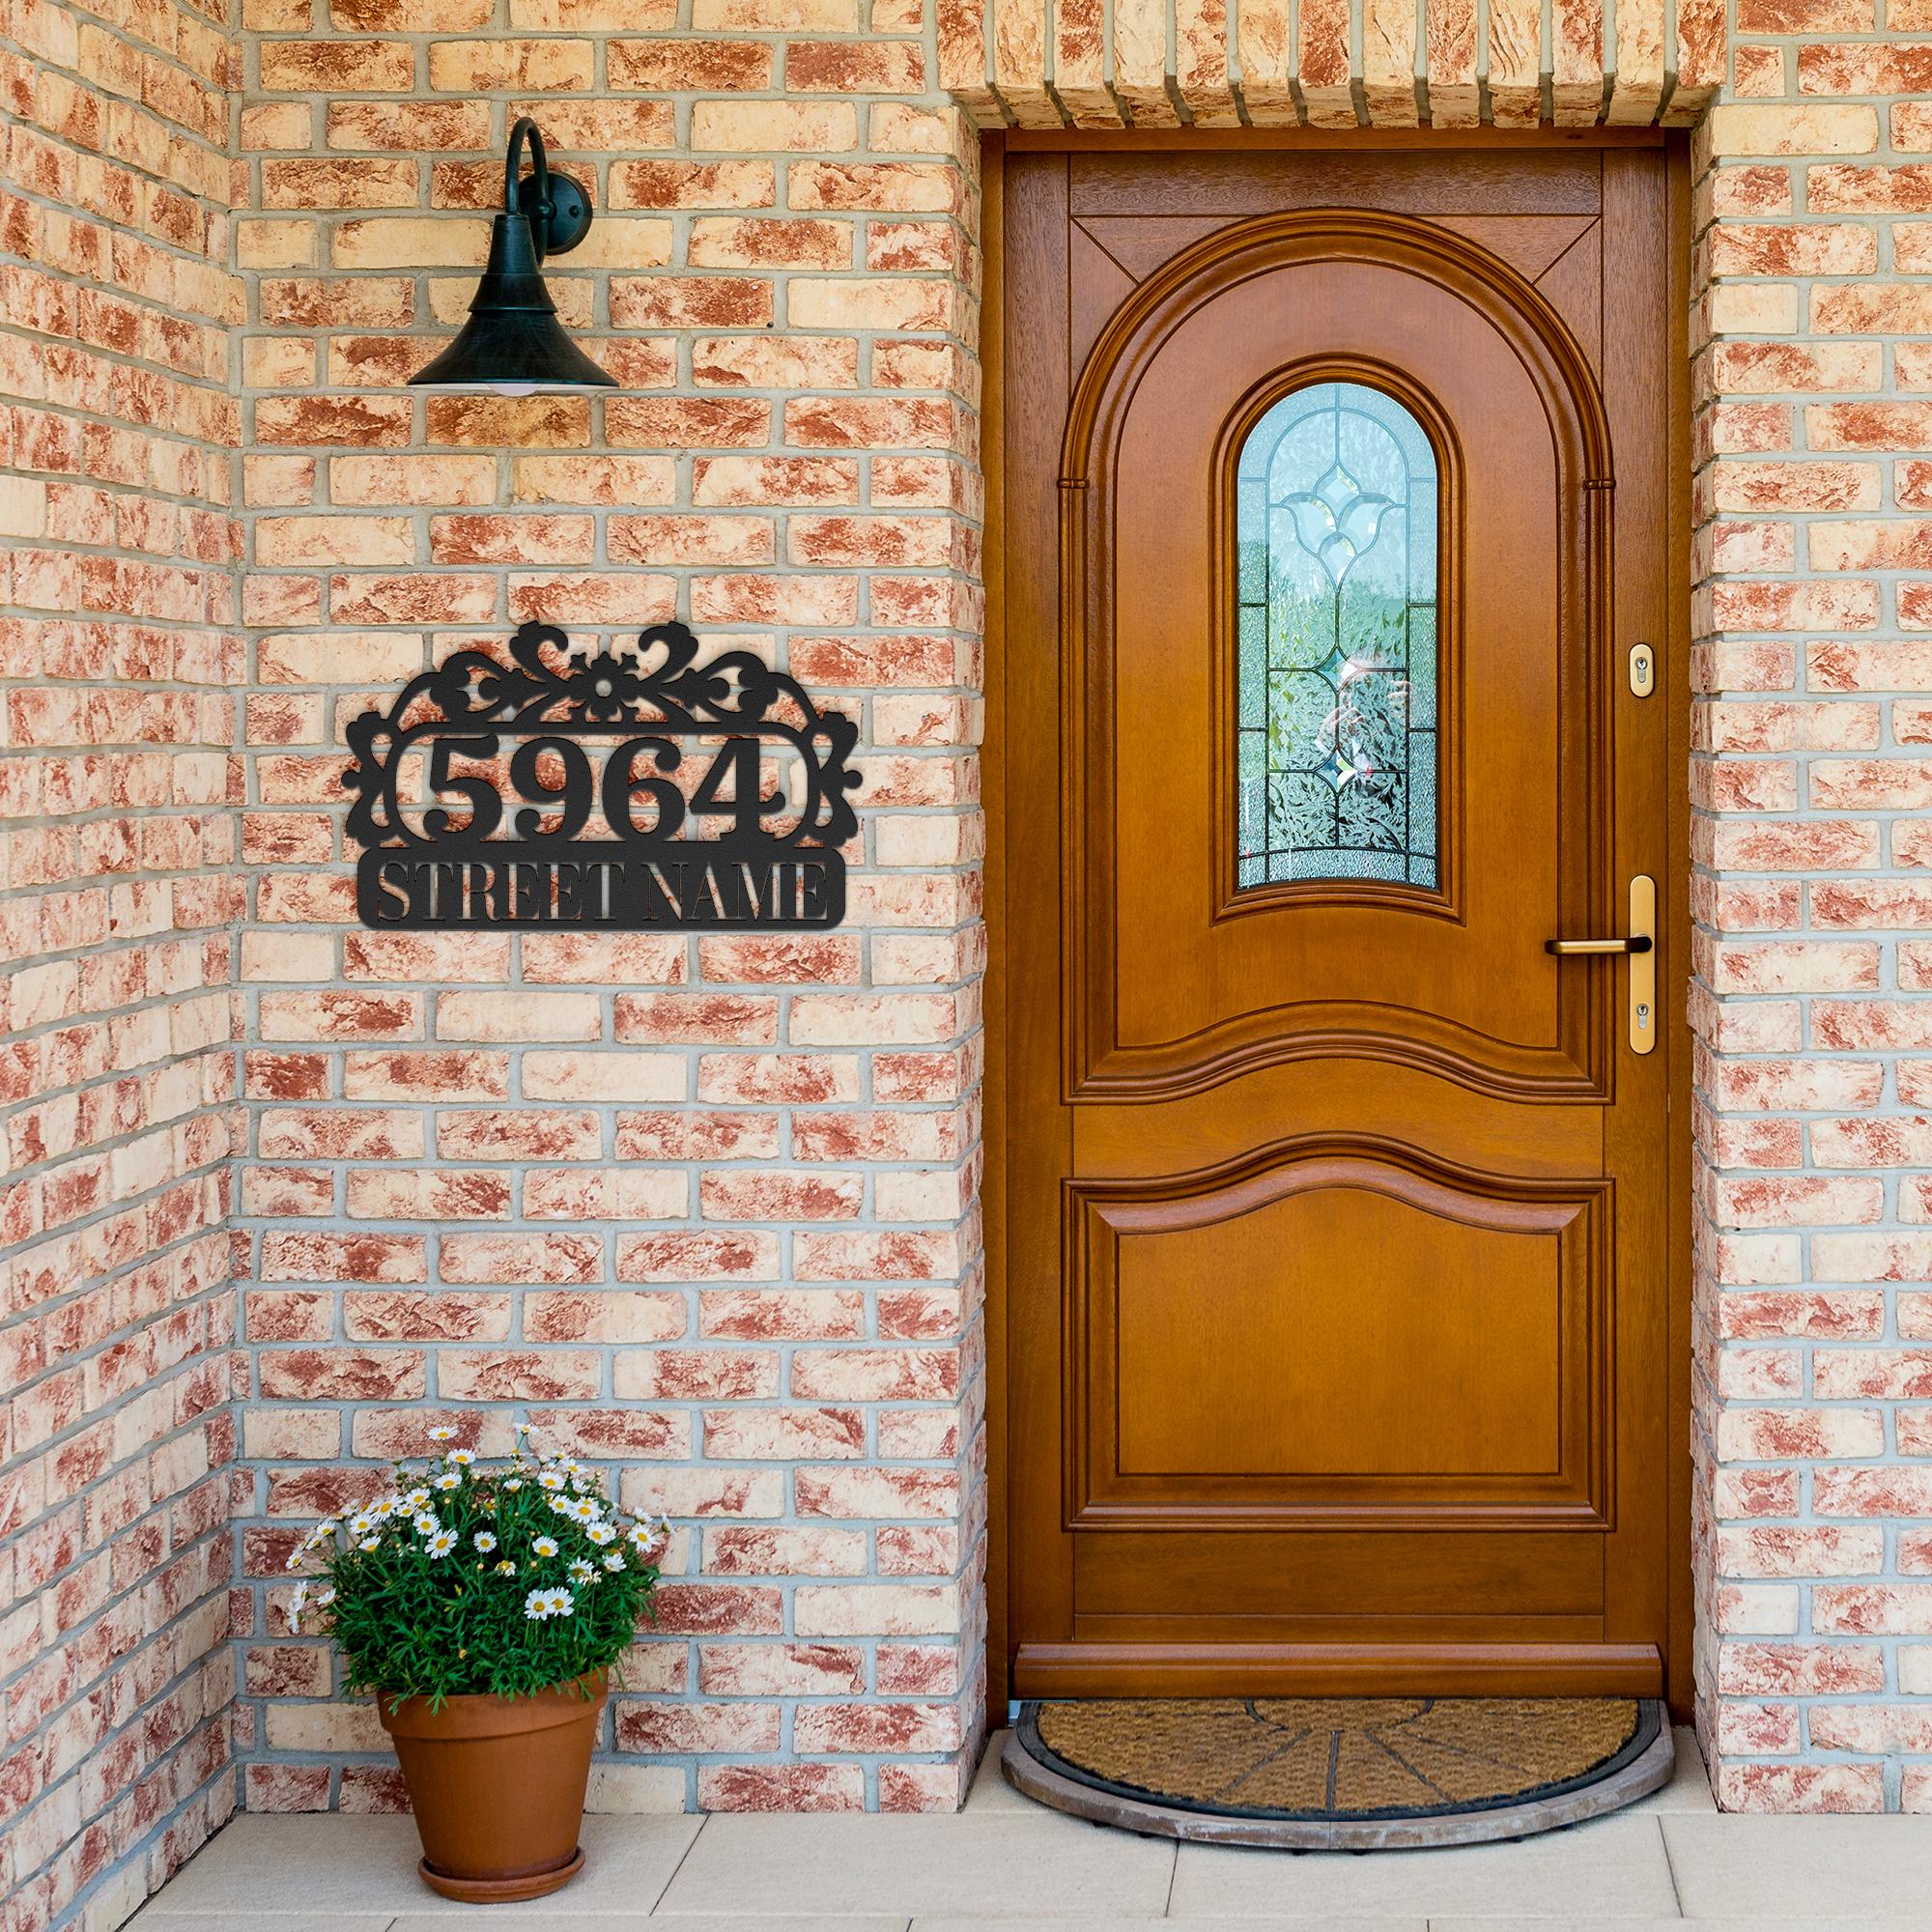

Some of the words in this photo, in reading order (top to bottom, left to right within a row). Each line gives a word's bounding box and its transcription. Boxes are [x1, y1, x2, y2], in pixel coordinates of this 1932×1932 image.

[423, 733, 786, 842] 5964
[378, 861, 626, 923] STREET
[640, 861, 829, 923] NAME
